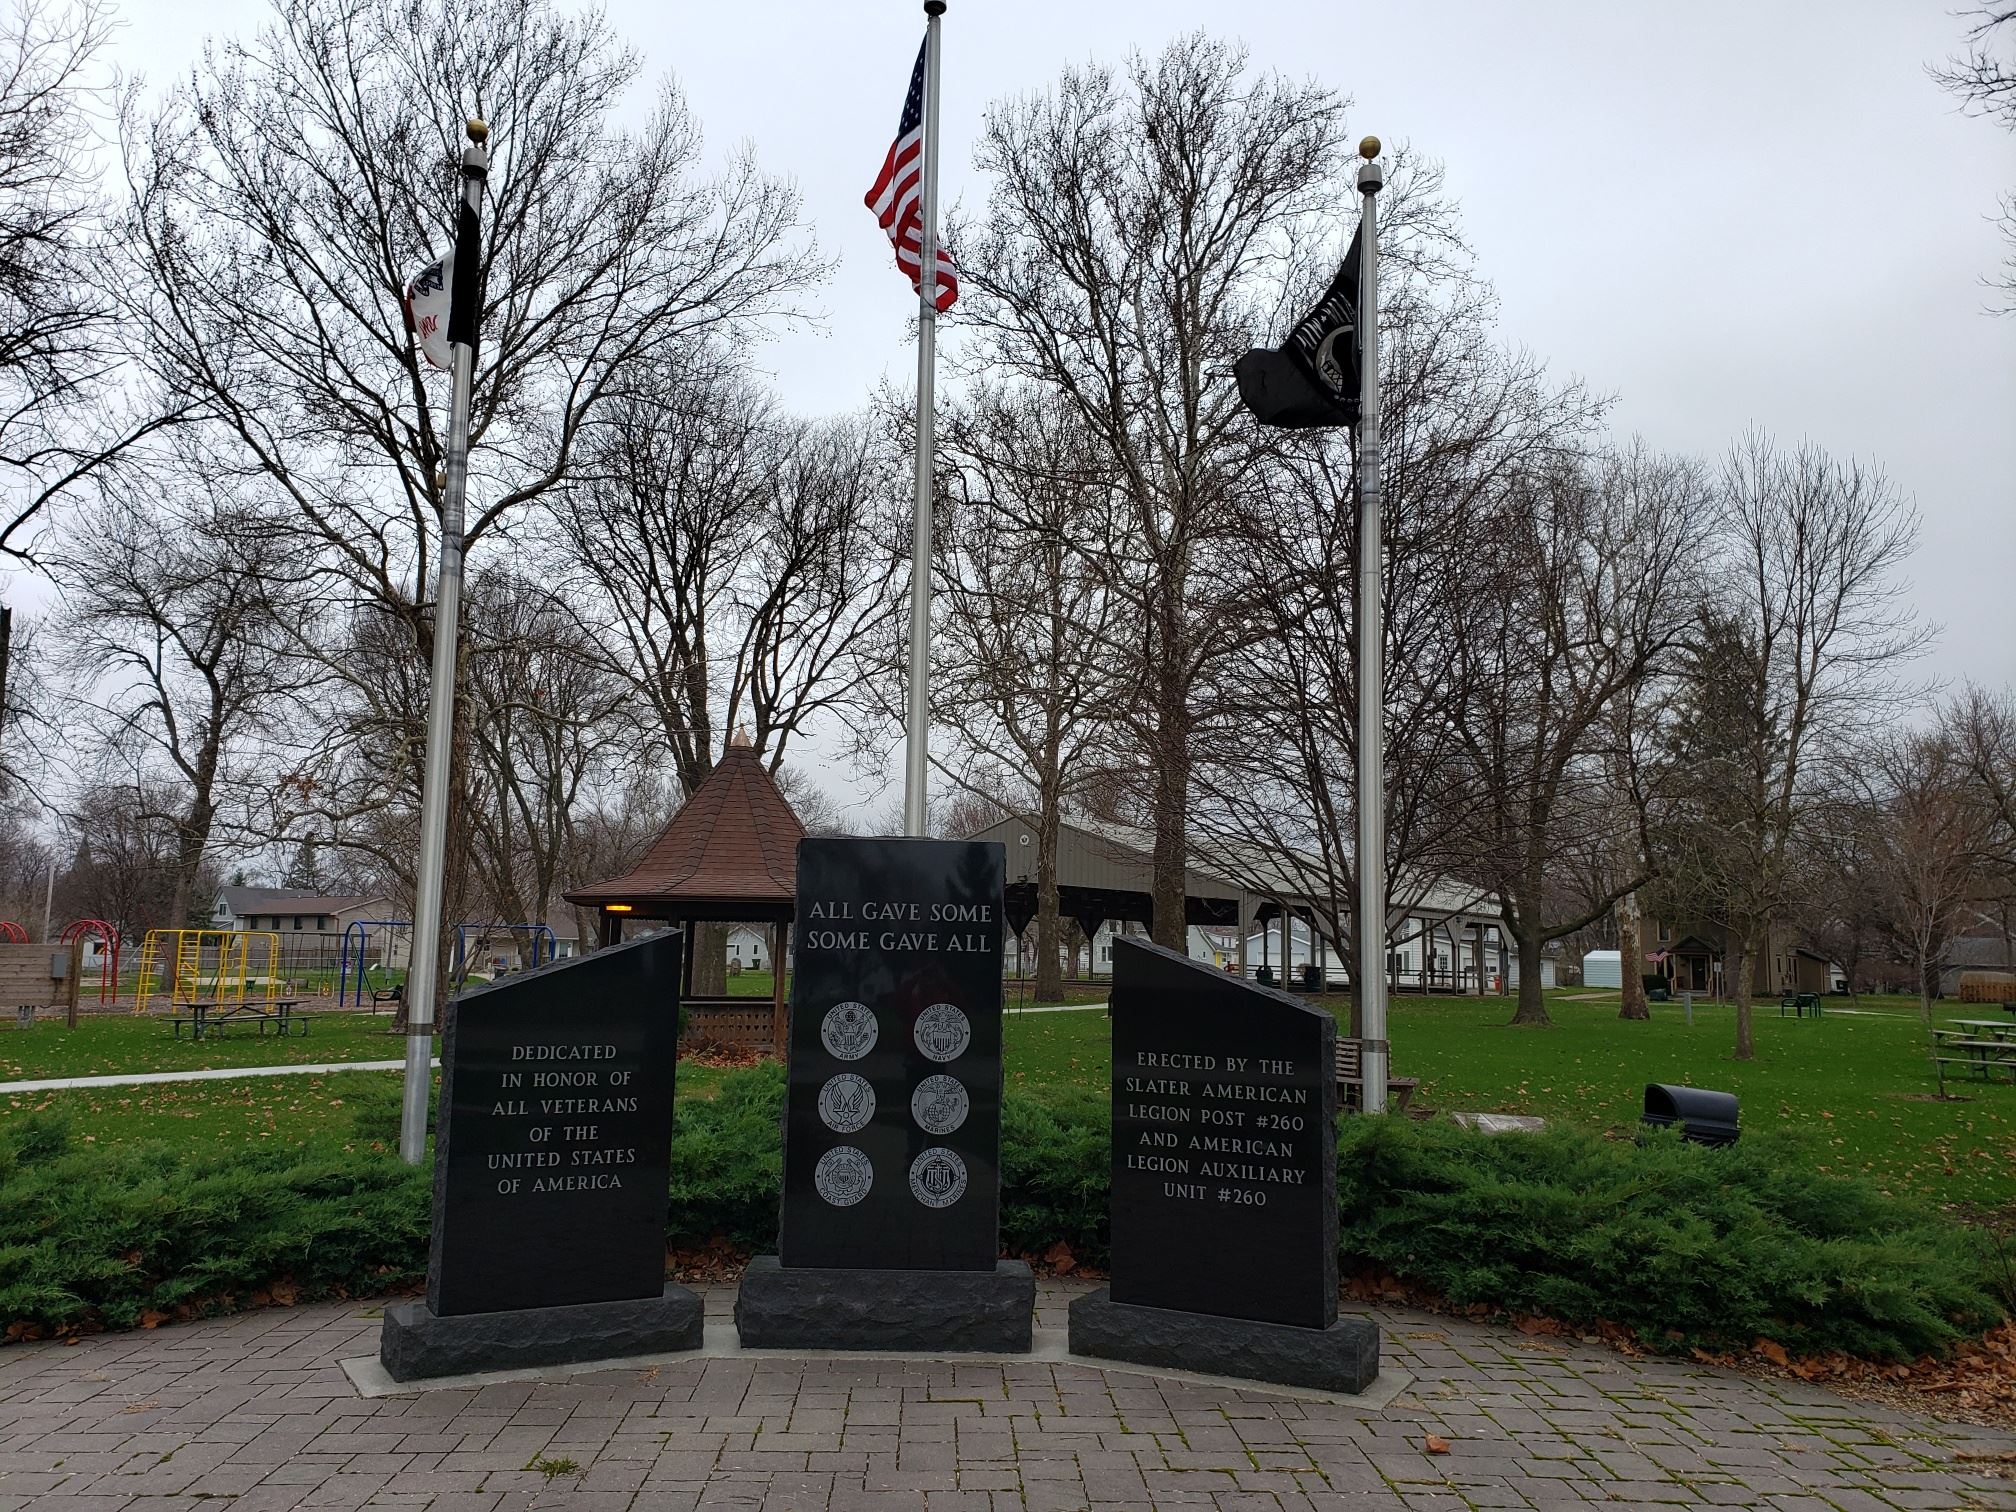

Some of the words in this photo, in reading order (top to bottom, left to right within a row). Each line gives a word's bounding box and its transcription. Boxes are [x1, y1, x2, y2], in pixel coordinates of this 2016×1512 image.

[809, 902, 853, 919] ALL
[863, 902, 920, 920] GAVE
[931, 904, 992, 922] SOME
[808, 931, 869, 950] SOME
[880, 933, 938, 951] GAVE
[947, 934, 991, 952] ALL
[827, 1003, 849, 1019] UNITED
[853, 1003, 873, 1020] STATES
[920, 1005, 941, 1021] UNITED
[945, 1005, 965, 1021] STATES
[512, 1045, 617, 1060] DEDICATED
[1137, 1052, 1216, 1070] ERECTED
[1226, 1058, 1248, 1072] BY
[1259, 1059, 1295, 1075] THE
[502, 1073, 522, 1088] IN
[534, 1072, 598, 1087] HONOR
[610, 1071, 631, 1086] OF
[824, 1074, 847, 1092] UNITED
[850, 1075, 871, 1093] STATES
[917, 1076, 939, 1093] UNITED
[943, 1077, 964, 1093] STATES
[1126, 1078, 1191, 1096] SLATER
[1202, 1084, 1307, 1104] AMERICAN
[492, 1100, 528, 1115] ALL
[541, 1098, 638, 1113] VETERANS
[827, 1121, 838, 1130] AIR
[842, 1121, 865, 1132] FORCE
[1129, 1104, 1190, 1122] LEGION
[1201, 1109, 1245, 1126] POST
[1256, 1115, 1304, 1131] #260
[529, 1127, 552, 1142] OF
[564, 1126, 599, 1141] THE
[925, 1125, 956, 1133] MARINES
[1139, 1132, 1178, 1148] AND
[1189, 1136, 1293, 1157] AMERICAN
[488, 1152, 560, 1169] UNITED
[572, 1148, 635, 1166] STATES
[820, 1147, 843, 1165] UNITED
[847, 1148, 869, 1165] STATES
[915, 1149, 937, 1166] UNITED
[941, 1149, 962, 1167] STATES
[1127, 1154, 1189, 1173] LEGION
[1200, 1162, 1306, 1185] AUXILIARY
[498, 1179, 521, 1194] OF
[532, 1174, 622, 1192] AMERICA
[910, 1179, 939, 1207] MERCHANT
[943, 1179, 967, 1205] MARINES
[820, 1188, 840, 1204] COAST
[844, 1188, 868, 1205] GUARD
[1164, 1183, 1206, 1200] UNIT
[1218, 1188, 1266, 1206] #260
